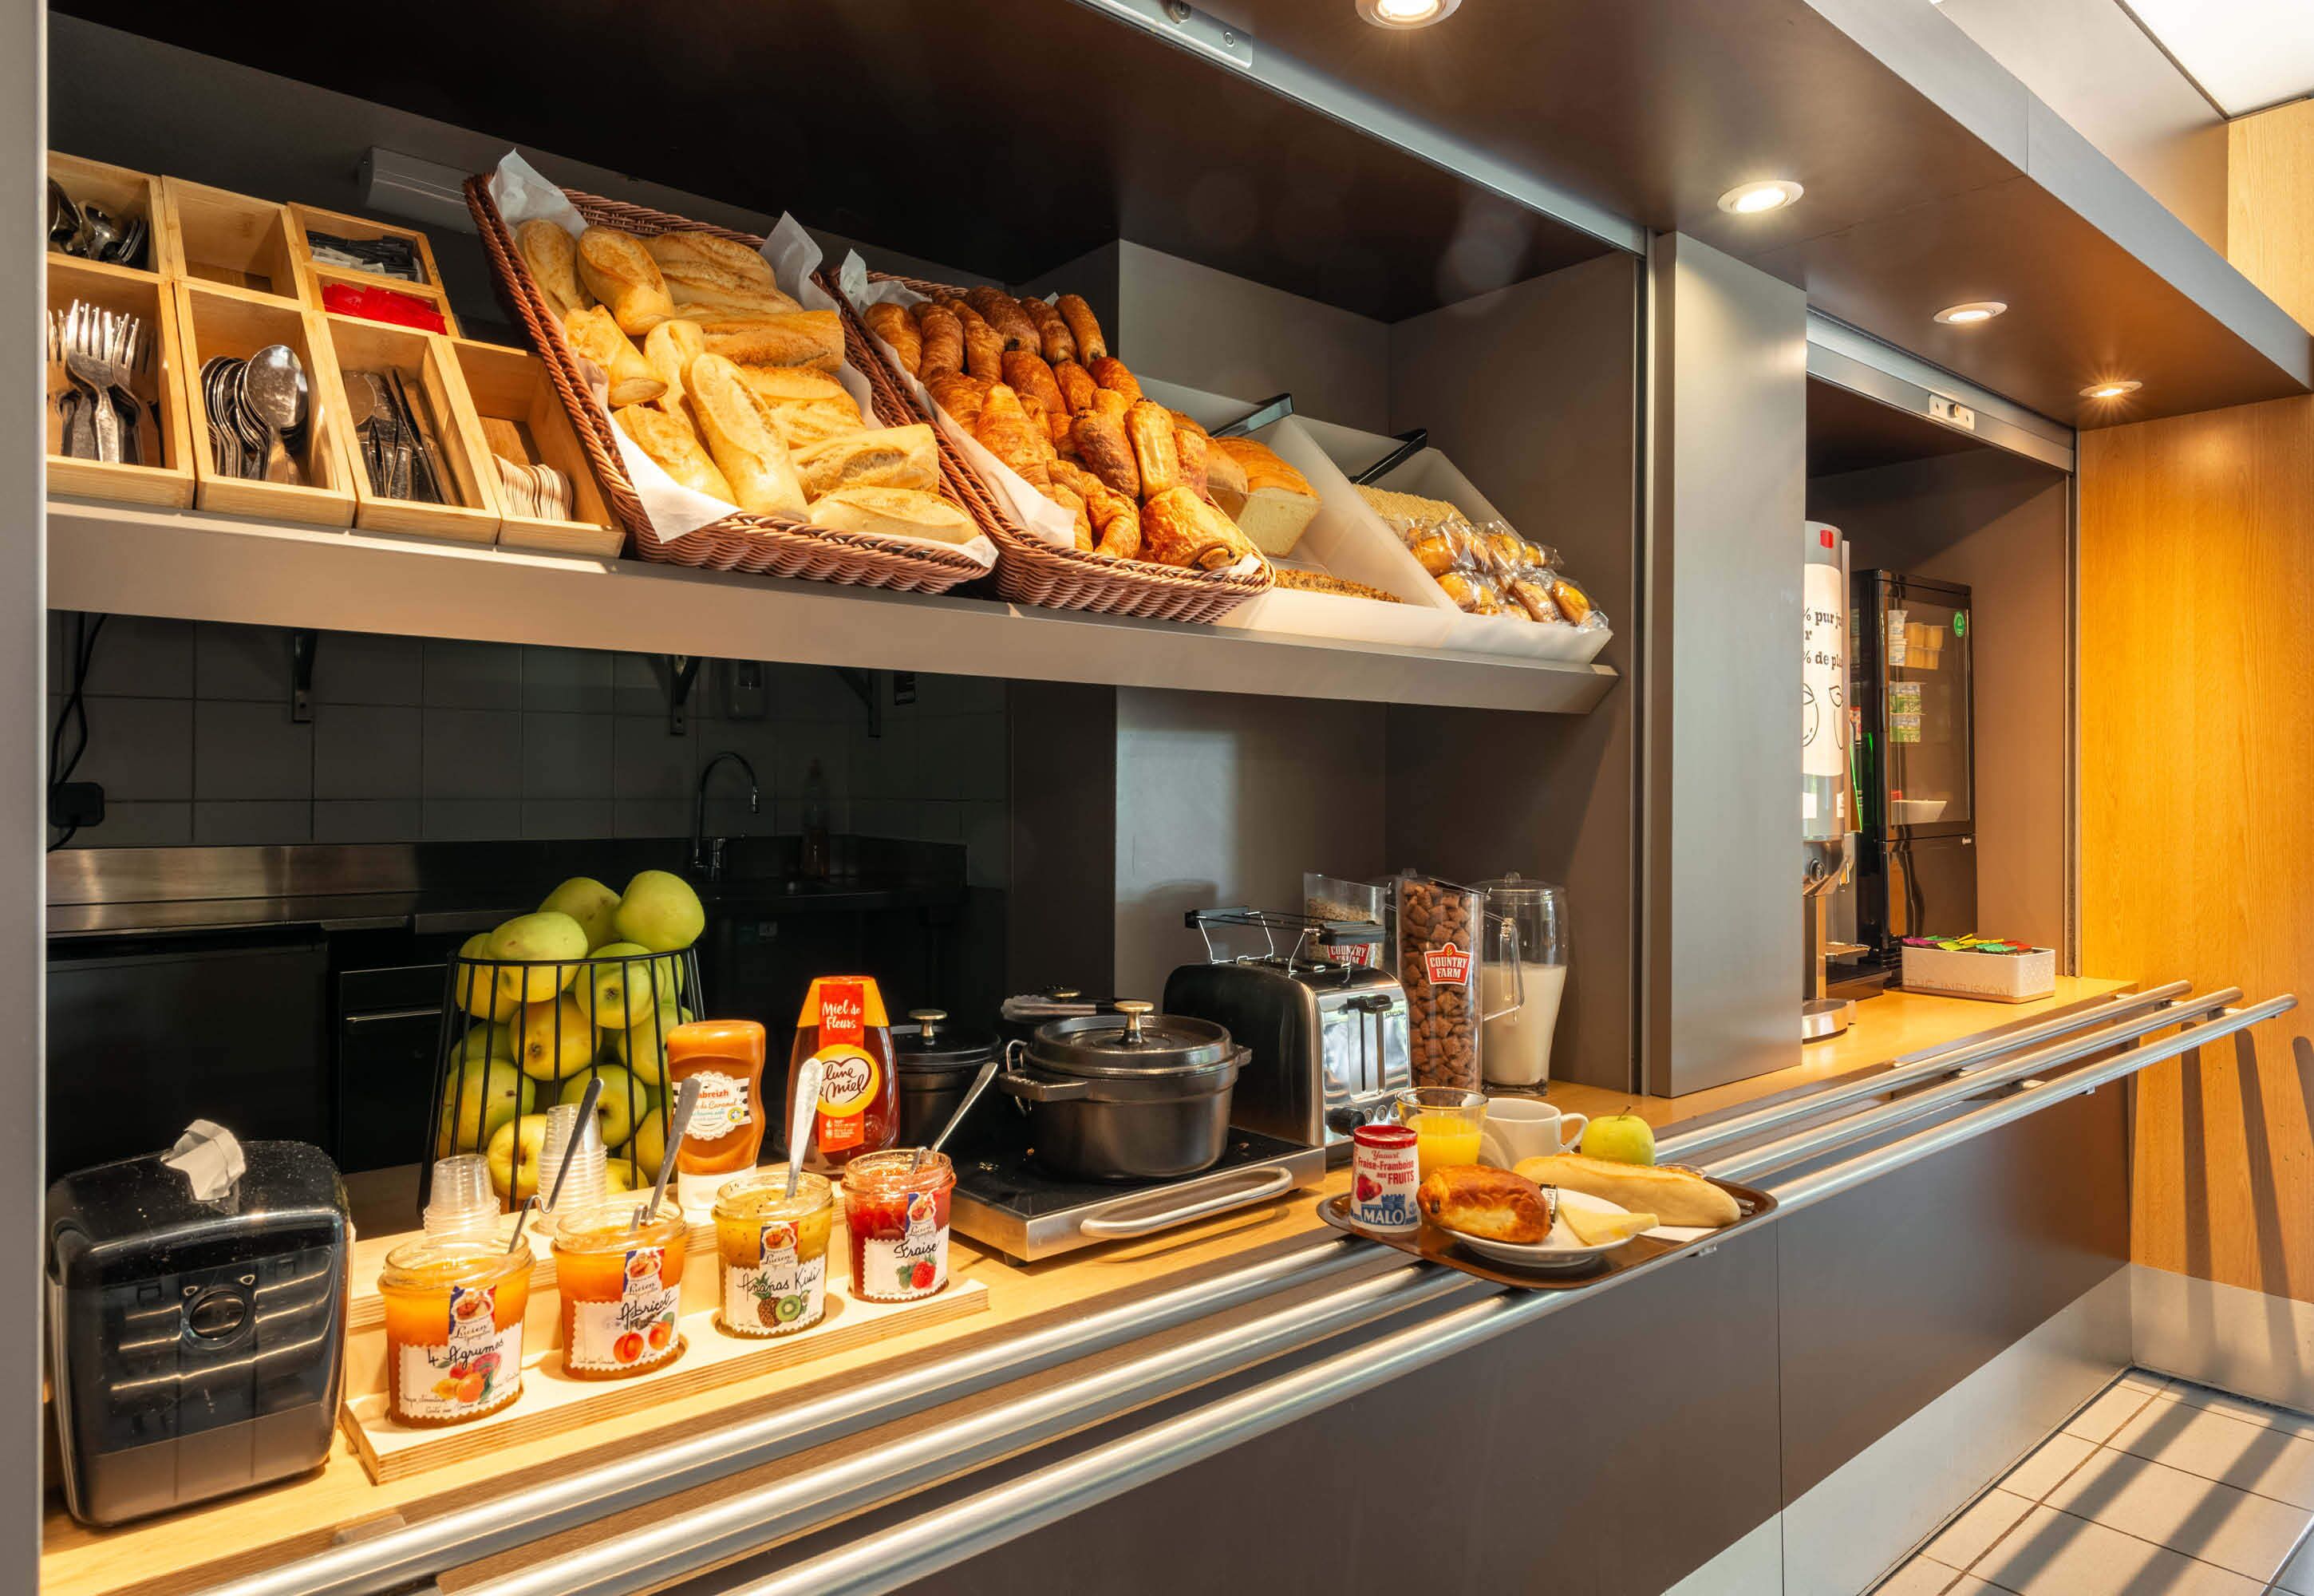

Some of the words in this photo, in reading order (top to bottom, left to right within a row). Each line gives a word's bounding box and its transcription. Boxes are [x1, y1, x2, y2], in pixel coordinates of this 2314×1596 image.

[1814, 611, 1834, 626] pur
[1814, 650, 1830, 666] de
[1429, 957, 1468, 969] COUNTRY
[1435, 967, 1462, 978] FARM
[822, 998, 849, 1017] Miel
[850, 1002, 862, 1016] de
[826, 1015, 857, 1031] Fleurs
[825, 1064, 857, 1081] lune
[825, 1073, 865, 1104] miel
[1388, 1170, 1415, 1185] FRUITS
[1363, 1208, 1405, 1225] MALO
[893, 1238, 940, 1259] Fraise
[736, 1272, 790, 1302] Ananas
[794, 1266, 822, 1294] Kiwi
[615, 1290, 677, 1331] Abricot
[427, 1347, 439, 1367] 4
[443, 1337, 504, 1370] Agrumes
